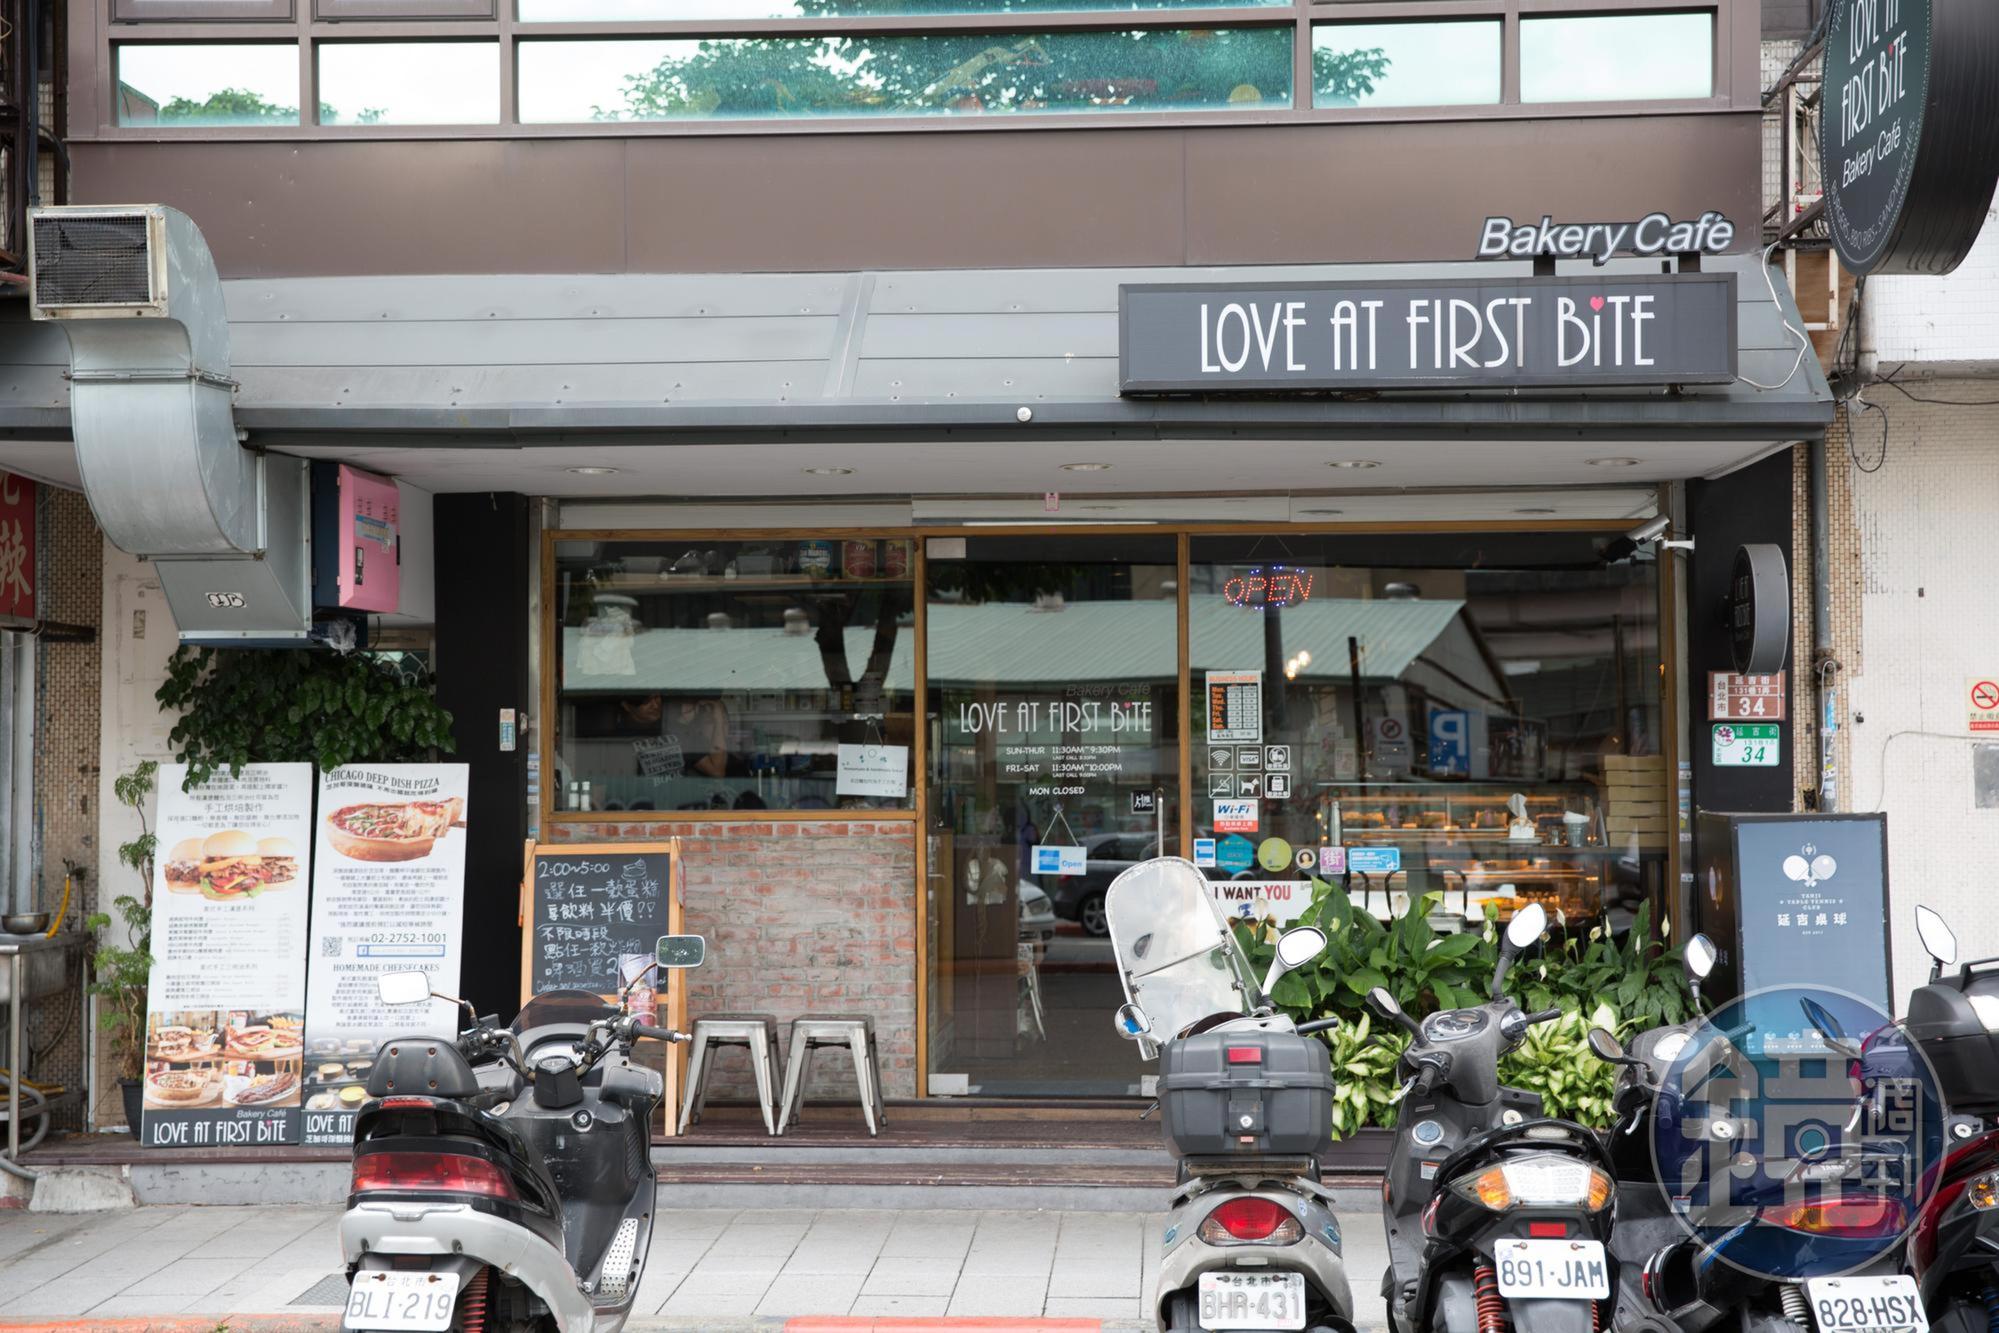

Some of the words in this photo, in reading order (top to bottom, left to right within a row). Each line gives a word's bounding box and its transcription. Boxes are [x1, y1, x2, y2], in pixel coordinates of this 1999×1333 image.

[1841, 59, 1875, 147] FIRST
[1842, 146, 1876, 188] Bakery
[1877, 117, 1901, 161] Café
[1480, 215, 1628, 263] Bakery
[1635, 212, 1734, 254] Café
[1201, 302, 1305, 372] LOVE
[1330, 300, 1383, 370] AT
[1406, 298, 1531, 368] FIRST
[1224, 574, 1313, 604] OPEN
[1739, 697, 1766, 716] 34
[961, 702, 1007, 733] LOVE
[1017, 702, 1039, 732] AT
[1049, 702, 1101, 732] FIRST
[1742, 746, 1765, 763] 34
[1006, 764, 1040, 772] FRI-SAT
[366, 772, 389, 785] DEEP
[391, 777, 412, 789] DISH
[413, 777, 440, 789] PIZZA
[1029, 787, 1050, 796] MON
[1052, 787, 1085, 795] CLOSED
[1218, 804, 1250, 814] Wi-Fi
[1062, 860, 1082, 869] Open
[1215, 887, 1218, 900] I
[1223, 886, 1261, 900] WANT
[1264, 885, 1291, 900] YOU
[371, 933, 447, 943] 02-2752-1001
[333, 964, 379, 972] HOMEMADE
[382, 964, 440, 972] CHEESECAKES
[236, 1110, 265, 1119] Bakery
[267, 1109, 286, 1118] Café
[154, 1122, 188, 1144] LOVE
[194, 1121, 210, 1143] AT
[216, 1120, 252, 1143] FIRST
[306, 1114, 334, 1133] LOVE
[339, 1114, 353, 1132] AT
[1232, 1276, 1272, 1287] 台北市
